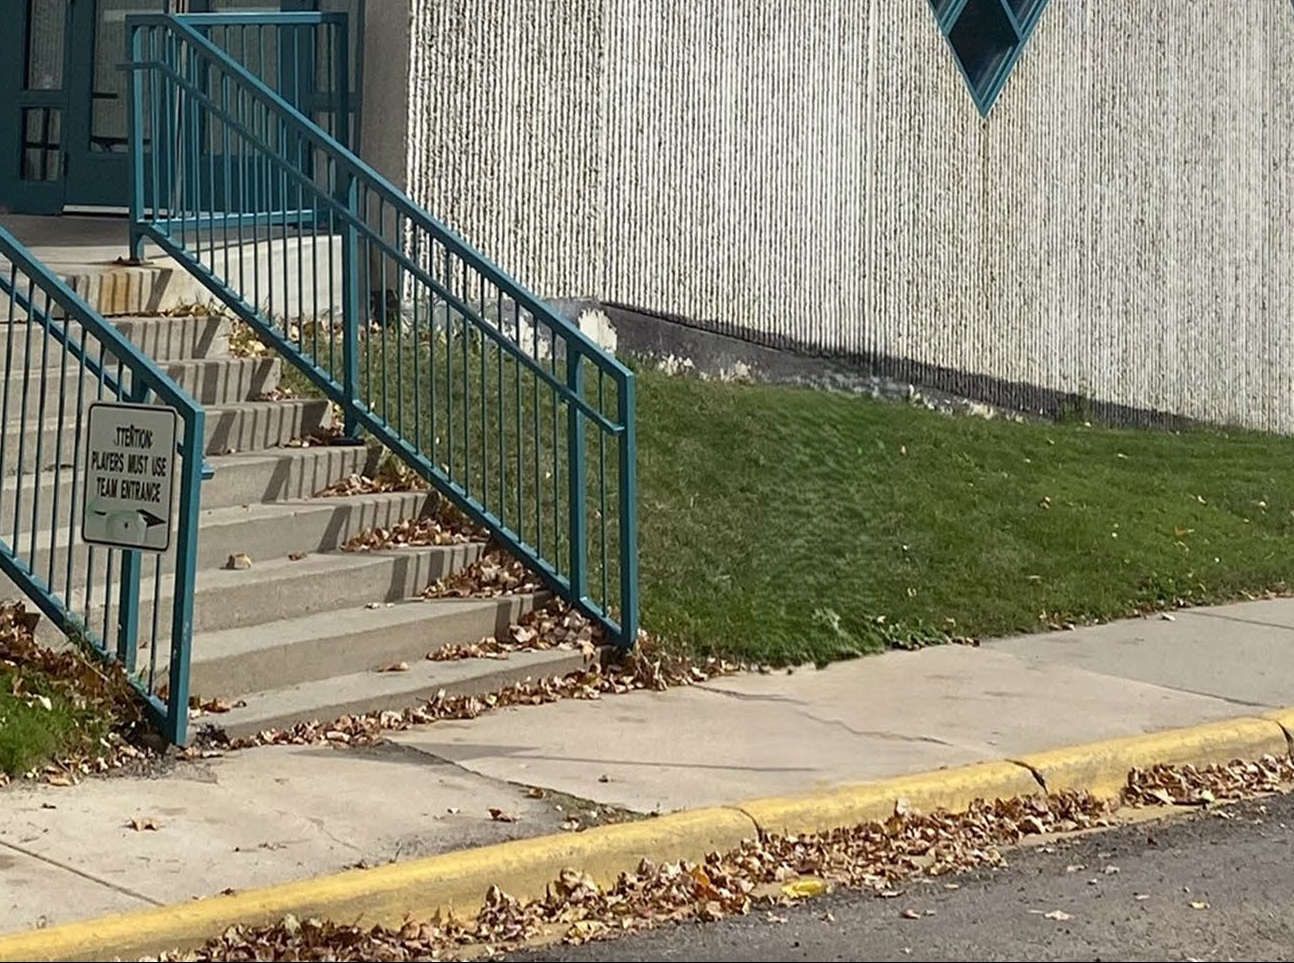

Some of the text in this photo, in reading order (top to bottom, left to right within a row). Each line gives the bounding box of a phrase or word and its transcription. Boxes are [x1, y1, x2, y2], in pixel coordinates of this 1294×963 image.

[114, 425, 153, 449] TTENTION
[91, 451, 167, 477] PLAYERS MUST USE
[96, 477, 161, 503] TEAM ENTRANCE
